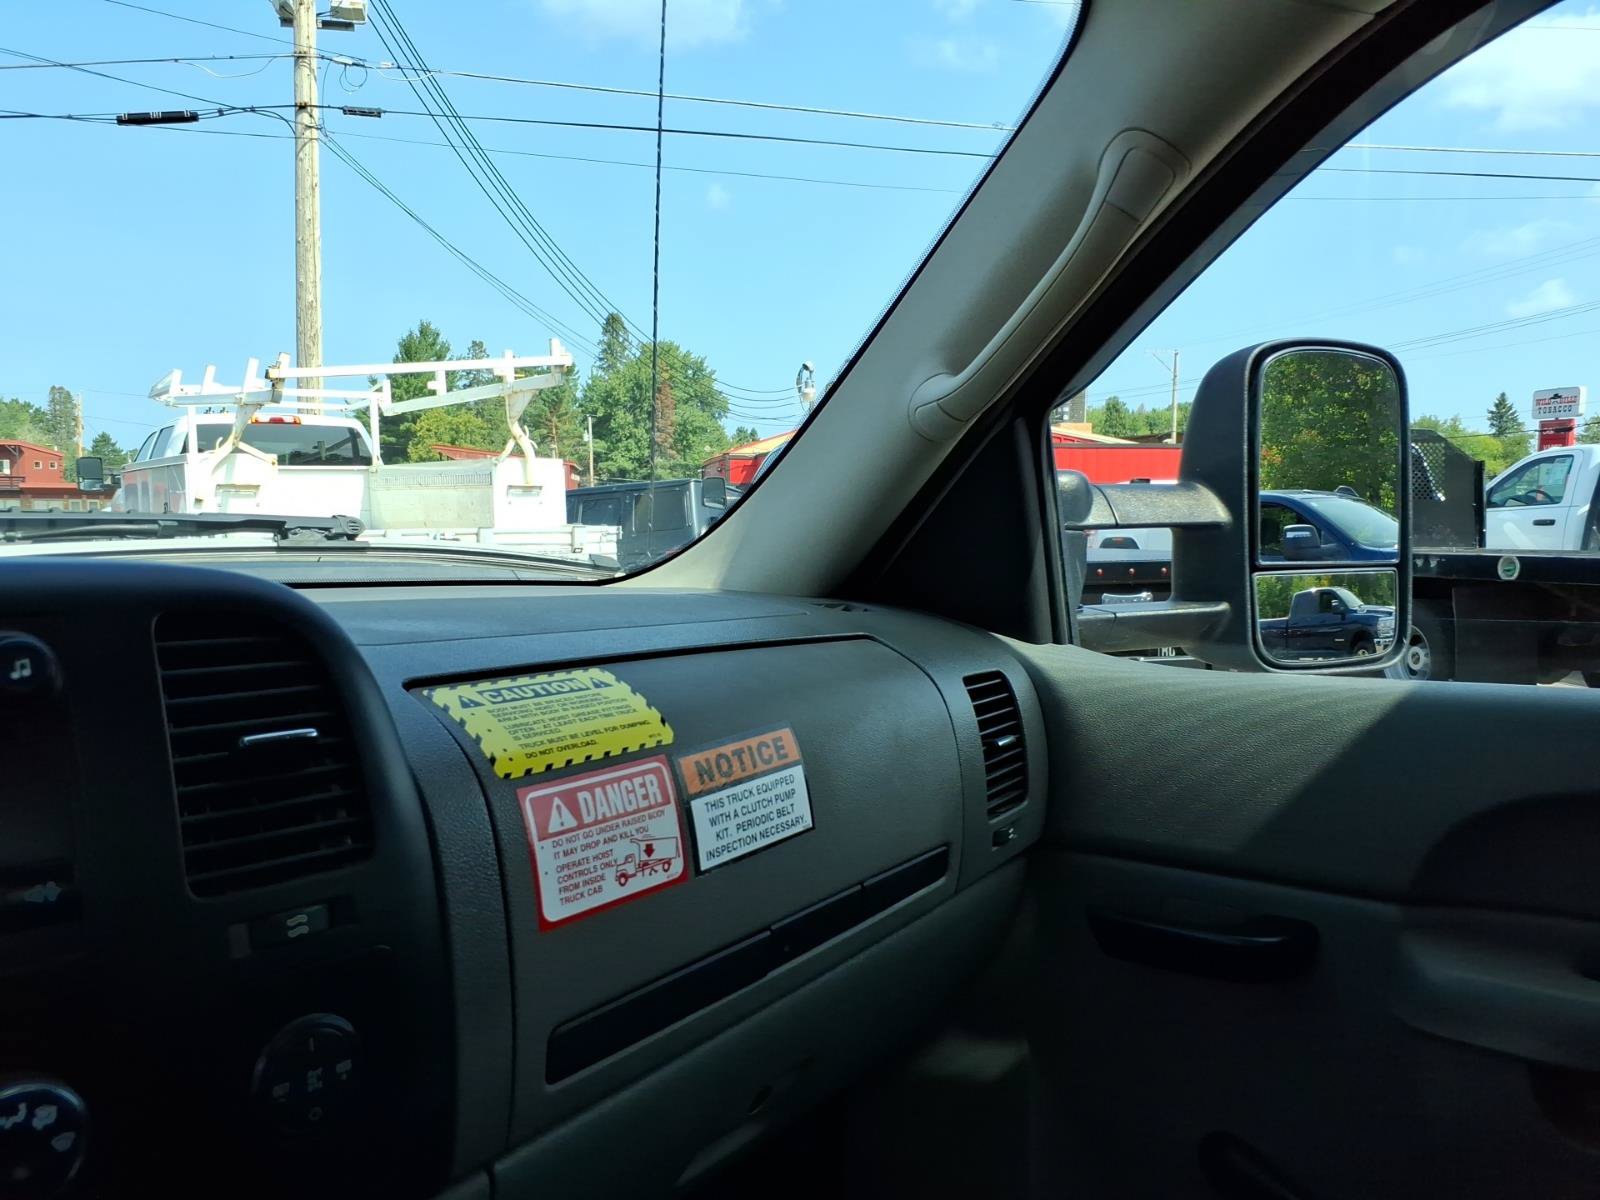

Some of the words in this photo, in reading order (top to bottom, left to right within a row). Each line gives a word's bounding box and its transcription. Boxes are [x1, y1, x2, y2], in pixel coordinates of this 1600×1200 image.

[1537, 404, 1573, 414] TOBACCO
[483, 680, 586, 702] CAUTION
[503, 719, 546, 730] LUBRICATE
[508, 727, 535, 735] OFTEN
[553, 719, 576, 727] LEAST
[519, 740, 547, 749] TRUCK
[547, 736, 567, 744] MUST
[538, 748, 553, 756] NOT
[695, 736, 789, 785] NOTICE
[578, 774, 662, 823] DANGER
[705, 798, 725, 812] THIS
[726, 788, 755, 805] TRUCK
[756, 774, 794, 795] EQUIPPED
[709, 811, 731, 827] WITH
[734, 809, 739, 819] A
[741, 796, 773, 816] CLUTCH
[774, 788, 796, 804] PUMP
[552, 839, 564, 848] DO
[565, 833, 580, 844] NOT
[582, 830, 594, 839] GO
[596, 822, 620, 835] UNDER
[622, 814, 646, 827] RAISED
[648, 809, 665, 820] BODY
[716, 827, 732, 841] KIT.
[736, 811, 775, 834] PERIODIC
[776, 803, 794, 818] BELT
[554, 851, 560, 859] IT
[563, 847, 577, 857] MAY
[580, 839, 601, 852] DROP
[603, 835, 618, 845] AND
[619, 831, 635, 840] KILL
[635, 826, 649, 834] YOU
[706, 833, 757, 861] INSPECTION
[759, 814, 807, 840] NECESSARY.
[556, 857, 590, 873] OPERATE
[592, 849, 613, 862] HOIST
[557, 865, 598, 884] CONTROLS
[600, 859, 619, 870] ONLY
[559, 882, 580, 895] FROM
[582, 873, 606, 887] INSIDE
[560, 891, 585, 905] TRUCK
[587, 885, 602, 896] CAB
